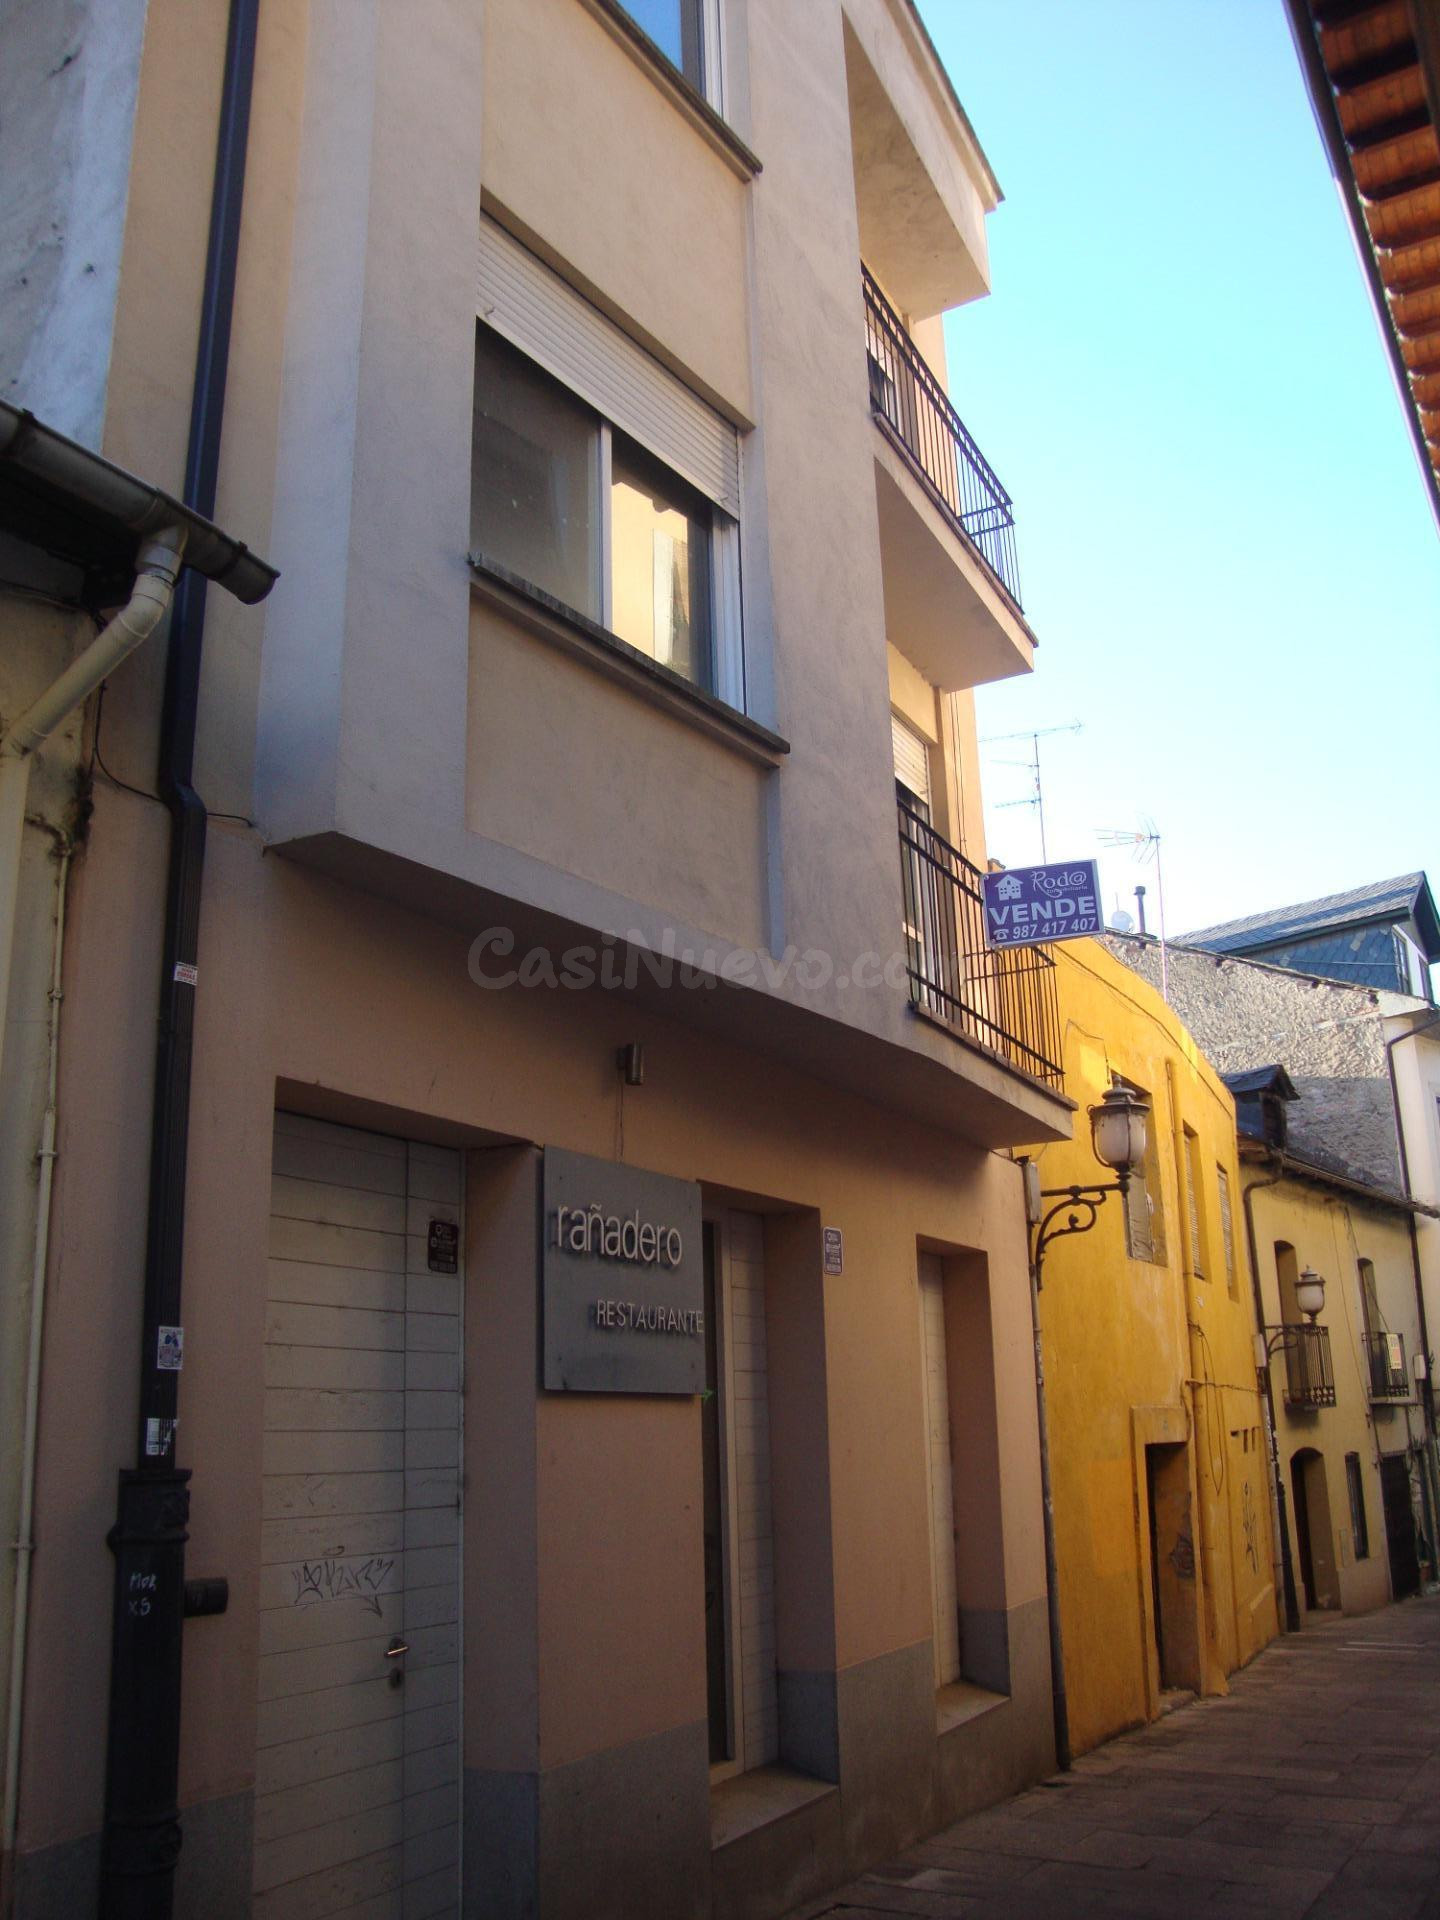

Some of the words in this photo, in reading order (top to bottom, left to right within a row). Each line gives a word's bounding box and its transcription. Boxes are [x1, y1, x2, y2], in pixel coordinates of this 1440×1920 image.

[1030, 870, 1087, 898] Rod@
[988, 896, 1096, 925] VENDE
[1012, 924, 1038, 939] 987
[1042, 920, 1067, 935] 417
[1071, 917, 1096, 932] 407
[557, 1204, 682, 1265] rañadero
[596, 1300, 705, 1333] RESTAURANTE
